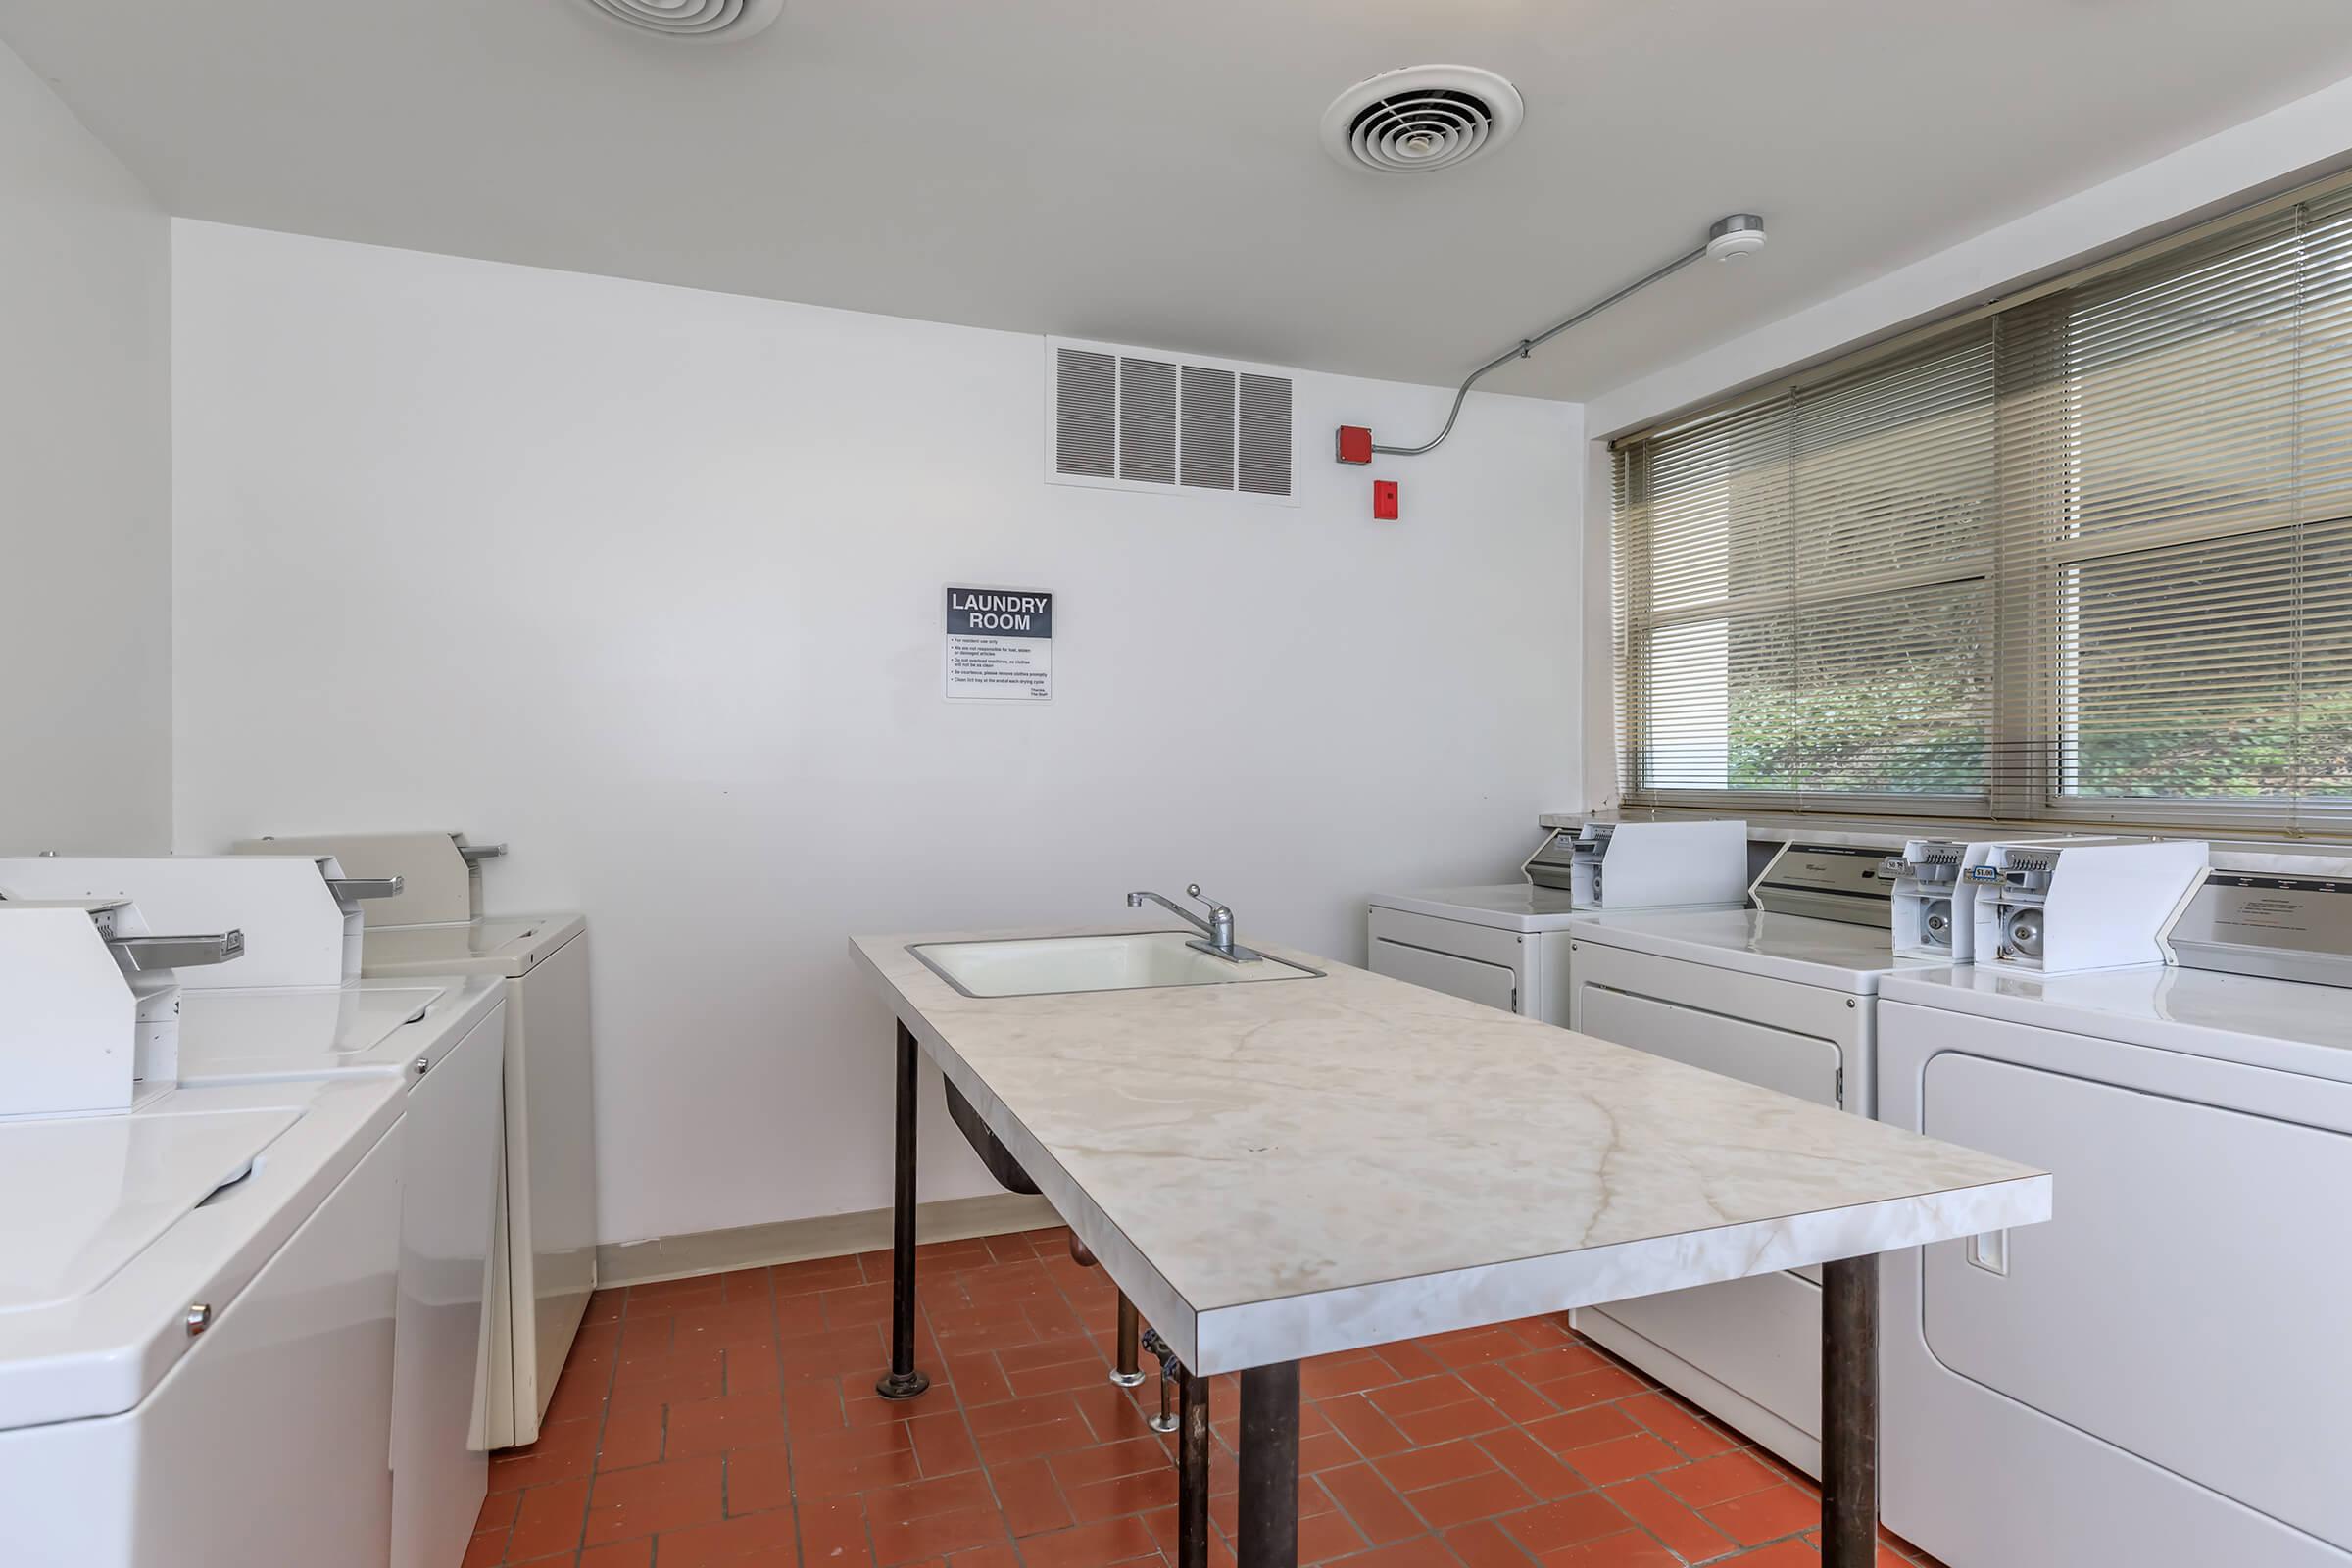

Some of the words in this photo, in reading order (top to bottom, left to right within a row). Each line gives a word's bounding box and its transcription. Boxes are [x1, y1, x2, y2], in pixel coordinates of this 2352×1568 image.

[953, 593, 1048, 613] LAUNDRY
[969, 612, 1031, 630] ROOM
[1976, 868, 1992, 877] $1.00
